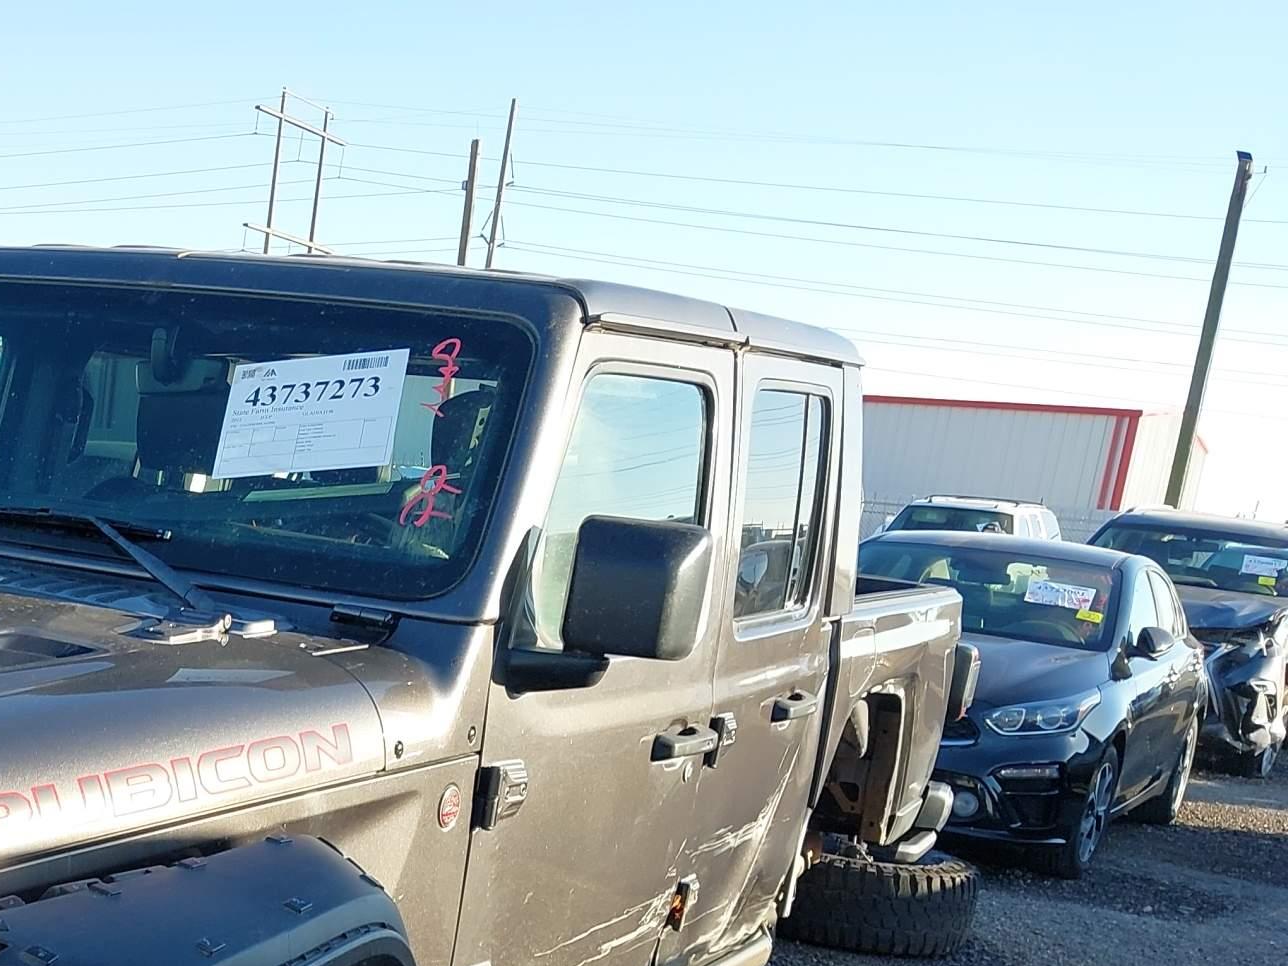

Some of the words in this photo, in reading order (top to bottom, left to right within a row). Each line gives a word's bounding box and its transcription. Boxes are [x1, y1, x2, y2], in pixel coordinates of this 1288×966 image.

[244, 376, 381, 407] 43737273
[232, 409, 250, 417] State
[250, 407, 270, 416] Farm
[271, 404, 305, 413] Insurance
